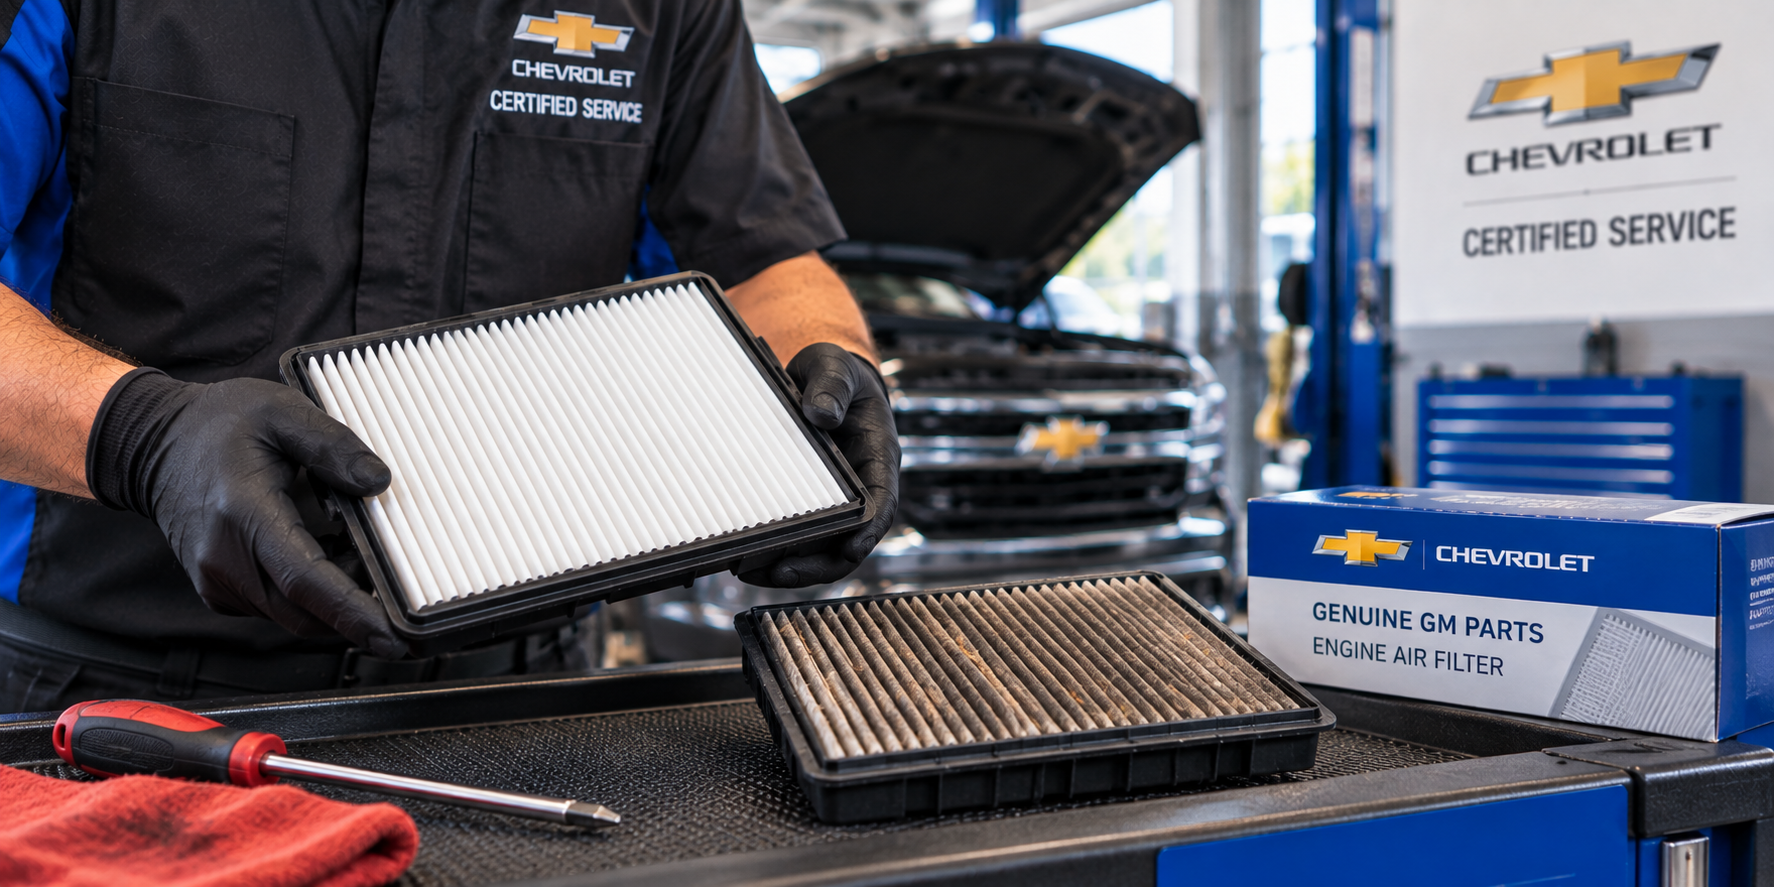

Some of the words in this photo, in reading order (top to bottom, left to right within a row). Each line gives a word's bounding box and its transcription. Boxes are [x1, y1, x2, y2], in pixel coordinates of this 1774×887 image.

[512, 59, 636, 88] CHEVROLET
[490, 89, 578, 117] CERTIFIED
[582, 98, 643, 124] SERVICE
[1465, 122, 1722, 176] CHEVROLET
[1462, 218, 1598, 258] CERTIFIED
[1608, 206, 1737, 248] SERVICE
[1436, 545, 1595, 573] CHEVROLET
[1312, 601, 1413, 631] GENUINE
[1420, 611, 1457, 635] GM
[1465, 616, 1544, 644] PARTS
[1313, 636, 1387, 663] ENGINE
[1393, 645, 1427, 668] AIR
[1434, 650, 1504, 677] FILTER
